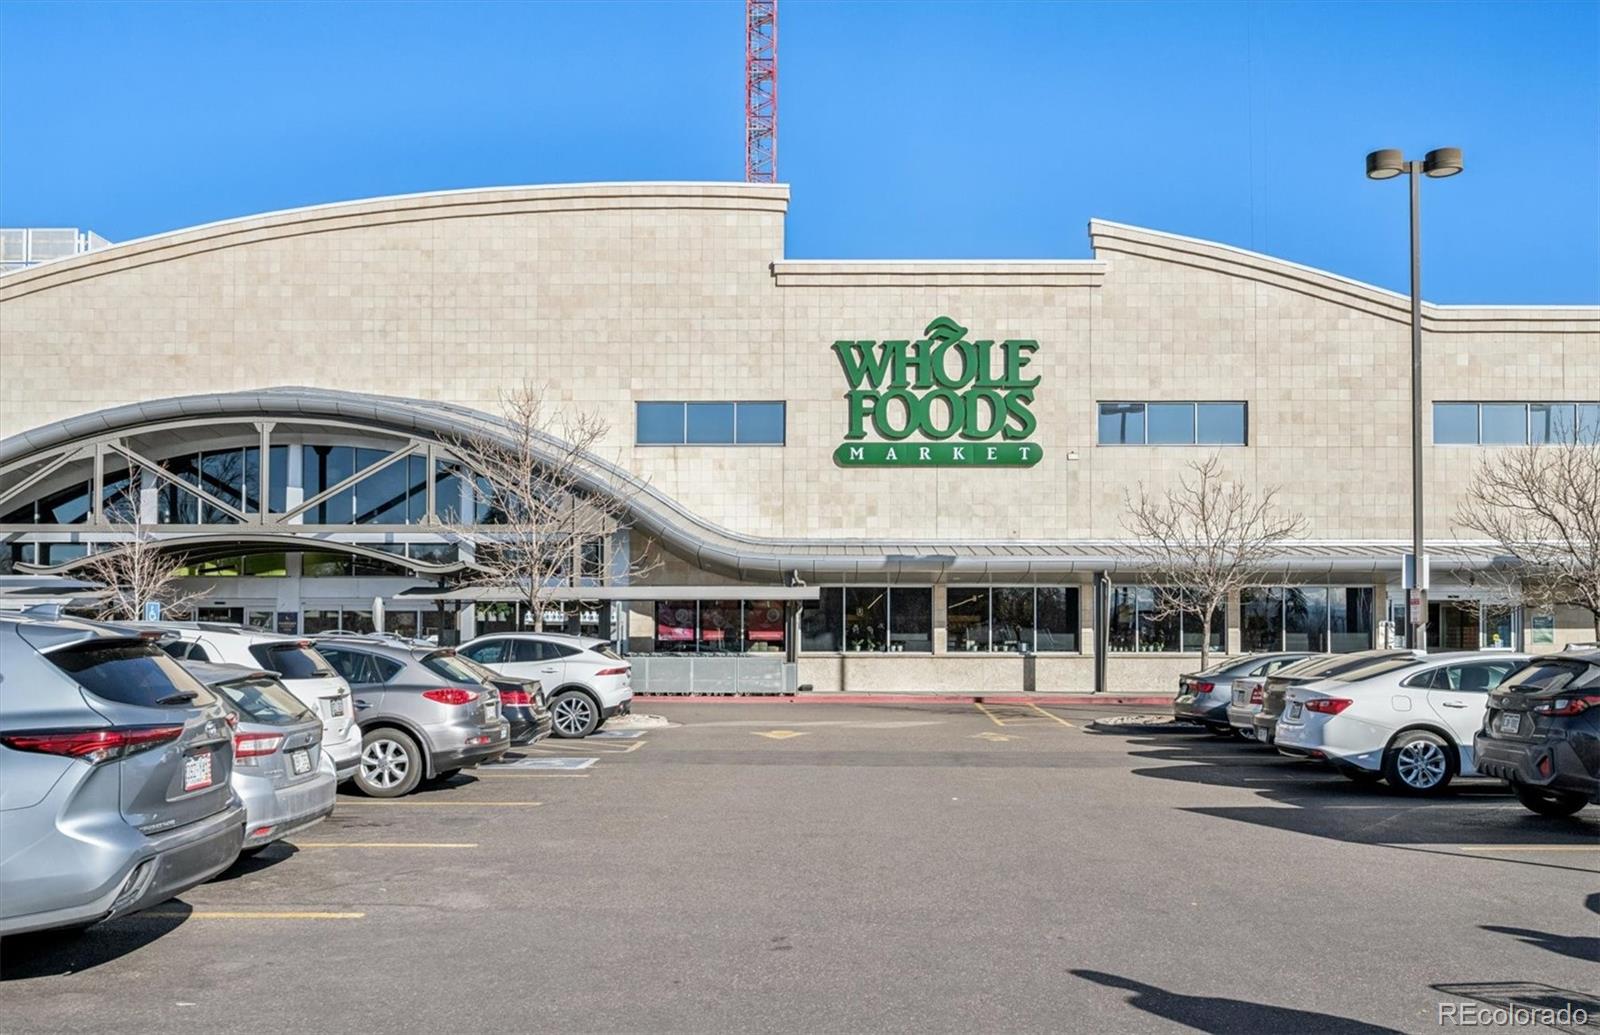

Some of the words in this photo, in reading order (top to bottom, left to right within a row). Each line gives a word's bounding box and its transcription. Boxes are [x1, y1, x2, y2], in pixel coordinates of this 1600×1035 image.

[830, 337, 1042, 390] WHOLE
[843, 388, 1038, 441] FOODS
[849, 447, 1031, 460] MARKET
